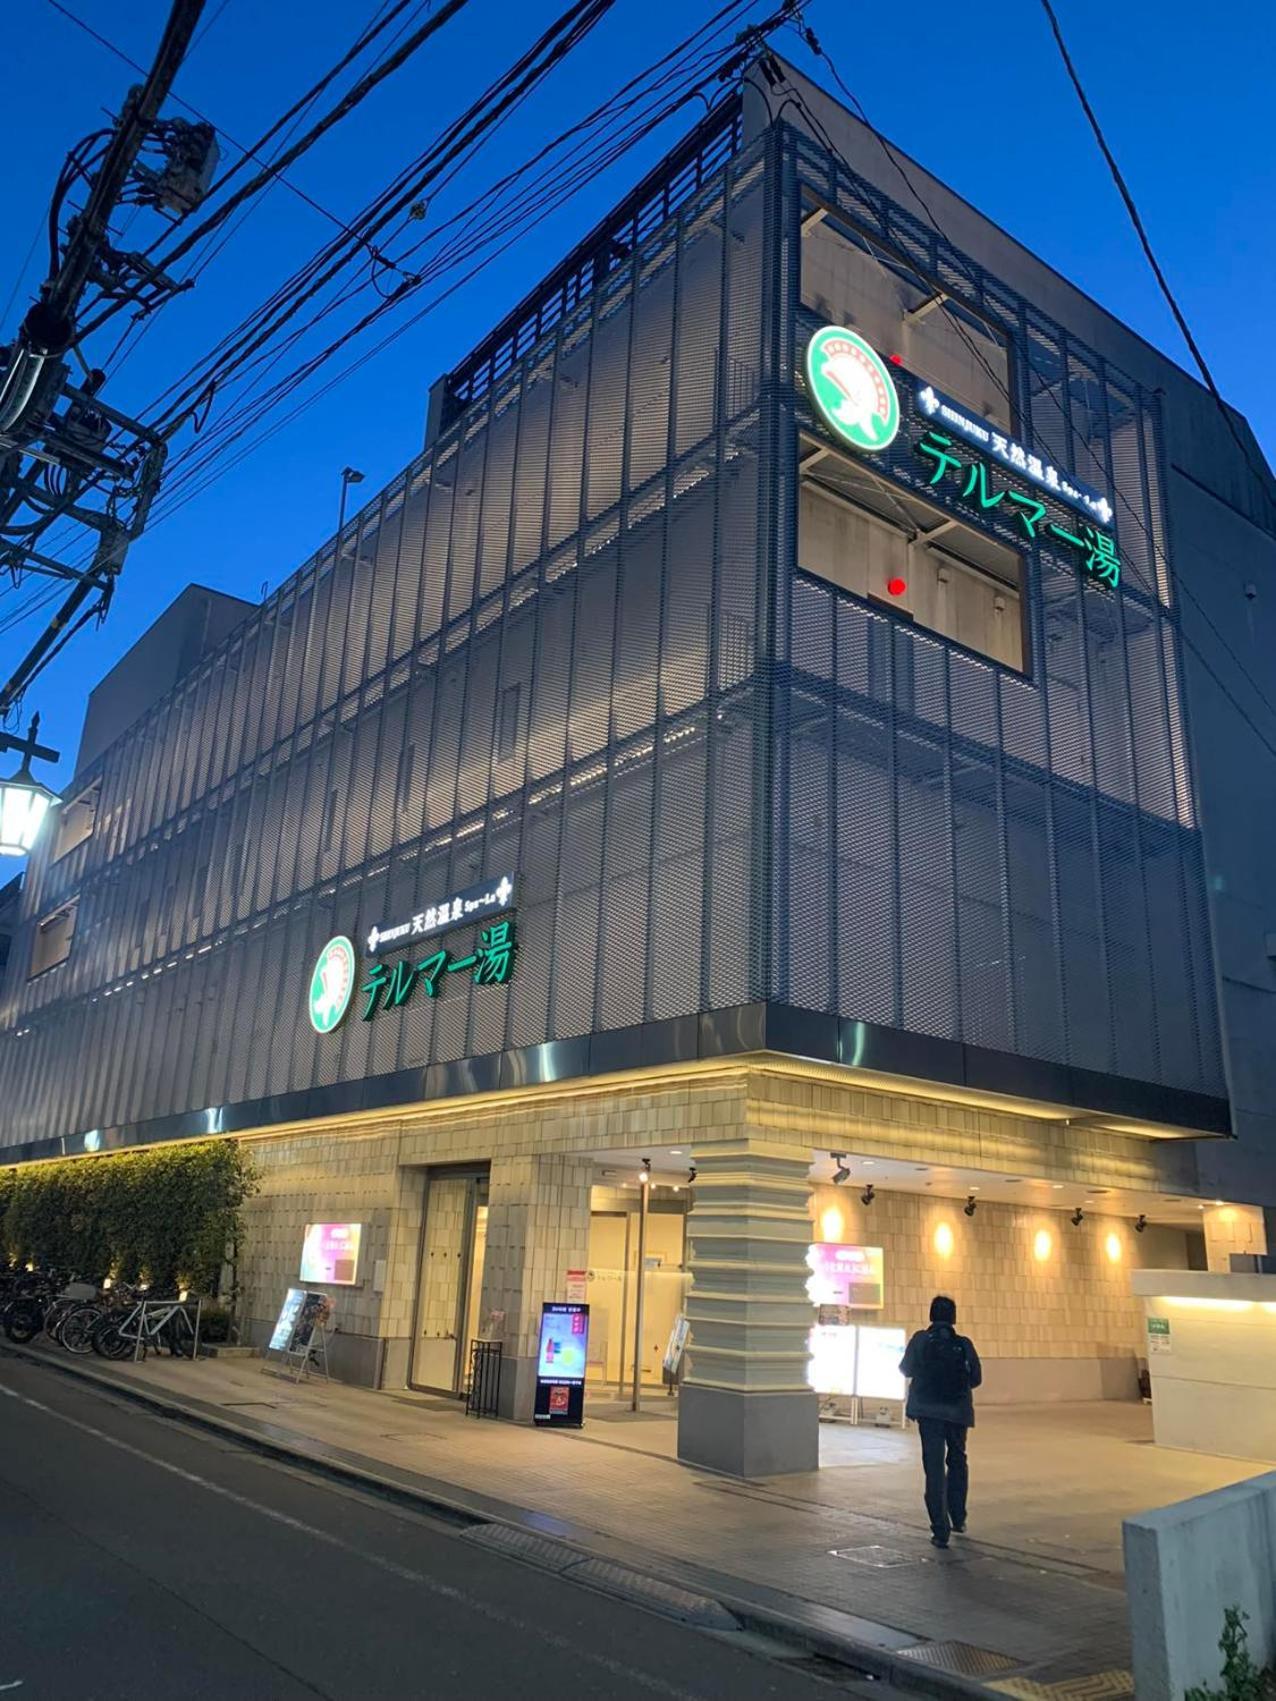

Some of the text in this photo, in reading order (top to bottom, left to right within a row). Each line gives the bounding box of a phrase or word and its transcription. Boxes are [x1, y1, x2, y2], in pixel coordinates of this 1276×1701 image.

[920, 432, 1120, 587] テルマー湯
[412, 897, 463, 934] 天然温泉
[361, 921, 512, 1020] テルマー湯
